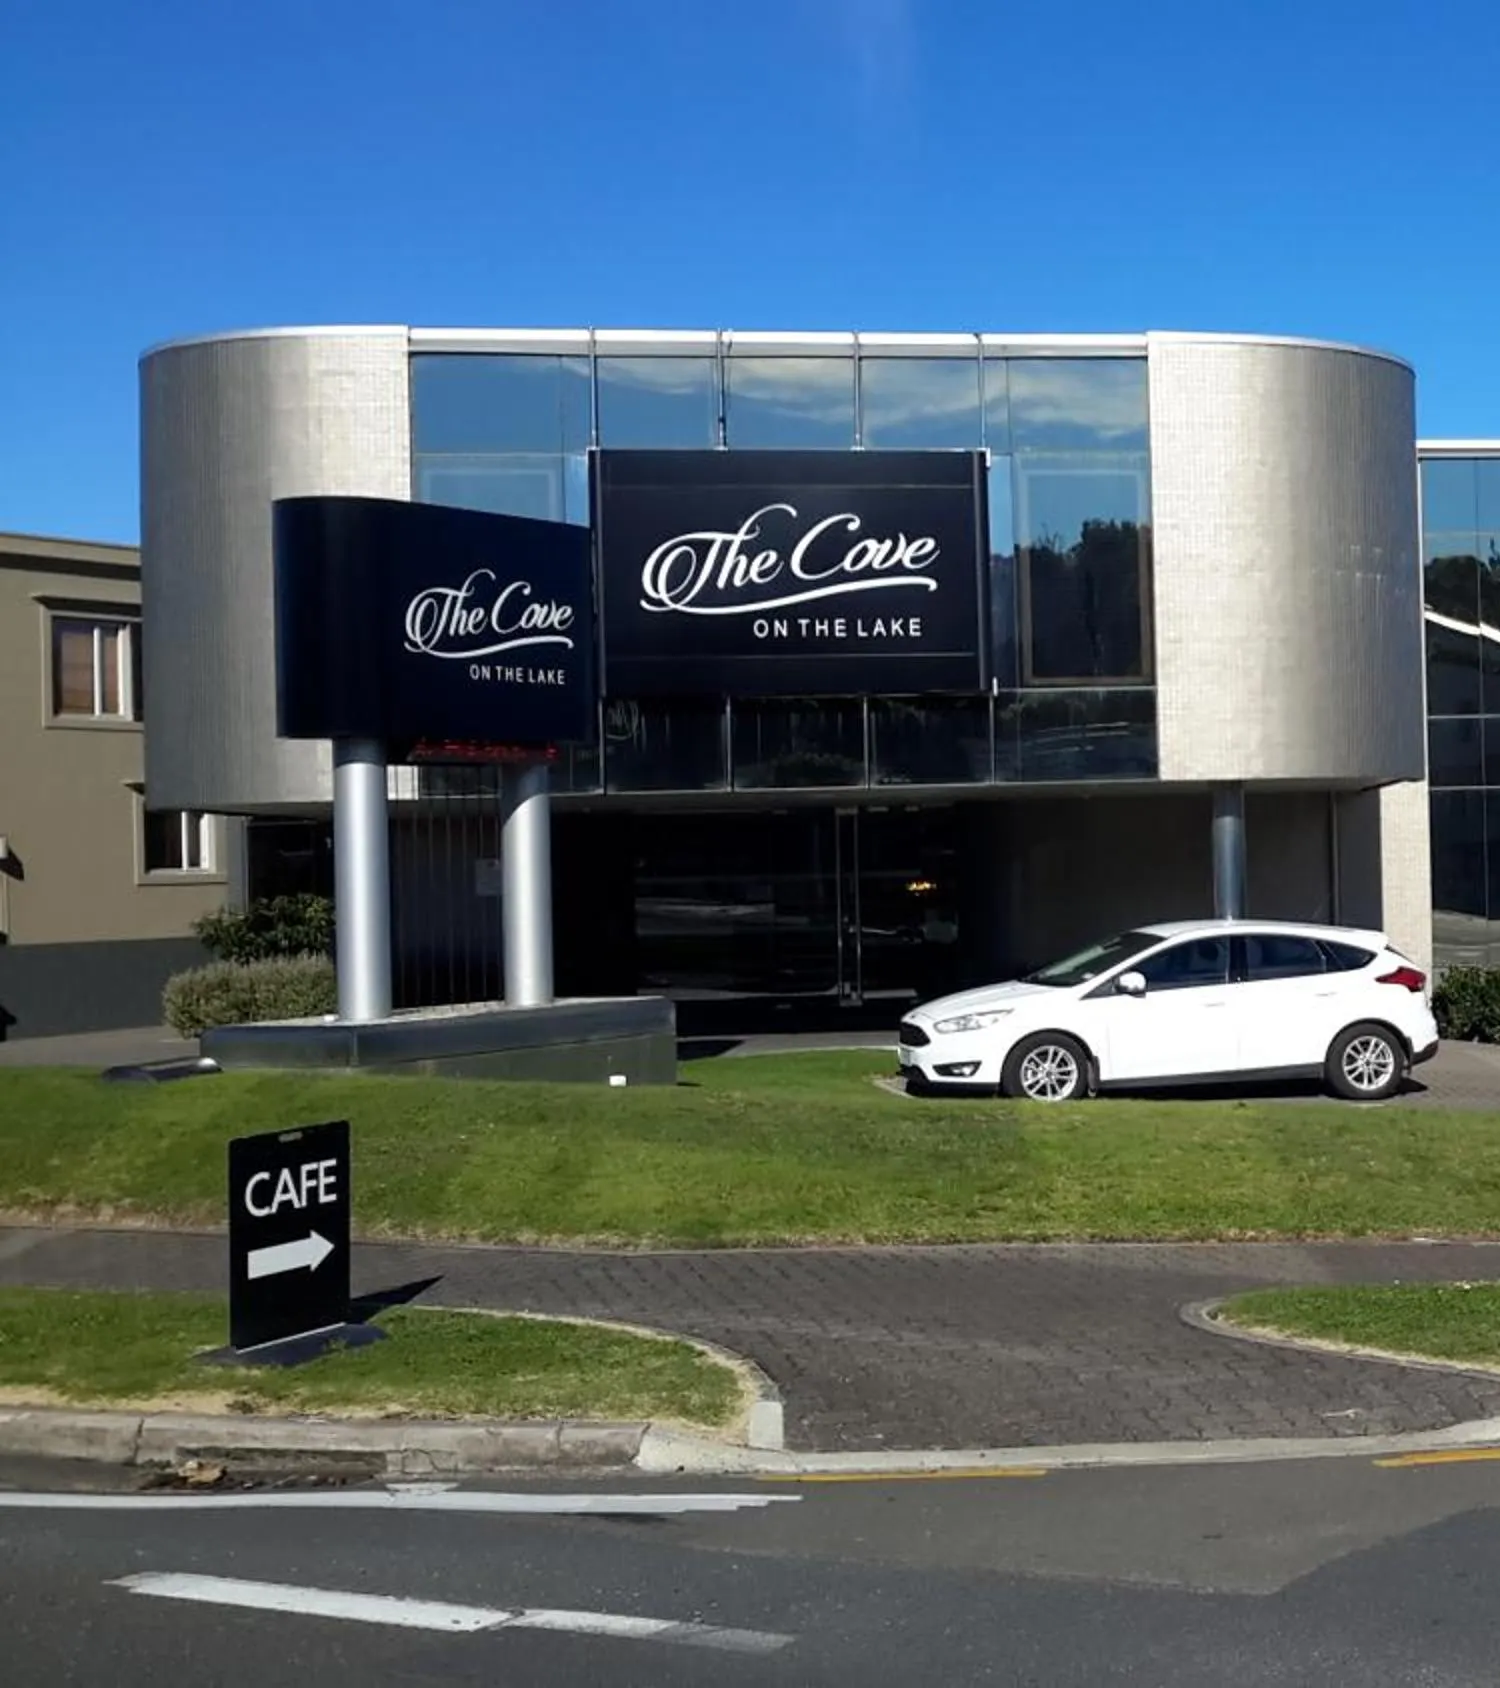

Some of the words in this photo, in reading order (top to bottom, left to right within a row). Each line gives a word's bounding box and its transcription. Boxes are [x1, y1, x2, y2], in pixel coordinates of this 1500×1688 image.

[641, 503, 797, 613] The
[790, 513, 940, 580] Cove
[404, 568, 497, 656] The
[491, 581, 575, 634] Cove
[753, 619, 788, 638] ON
[797, 618, 848, 638] THE
[856, 617, 923, 638] LAKE
[469, 663, 491, 681] ON
[496, 665, 524, 683] THE
[528, 667, 565, 685] LAKE
[244, 1158, 337, 1217] CAFE
